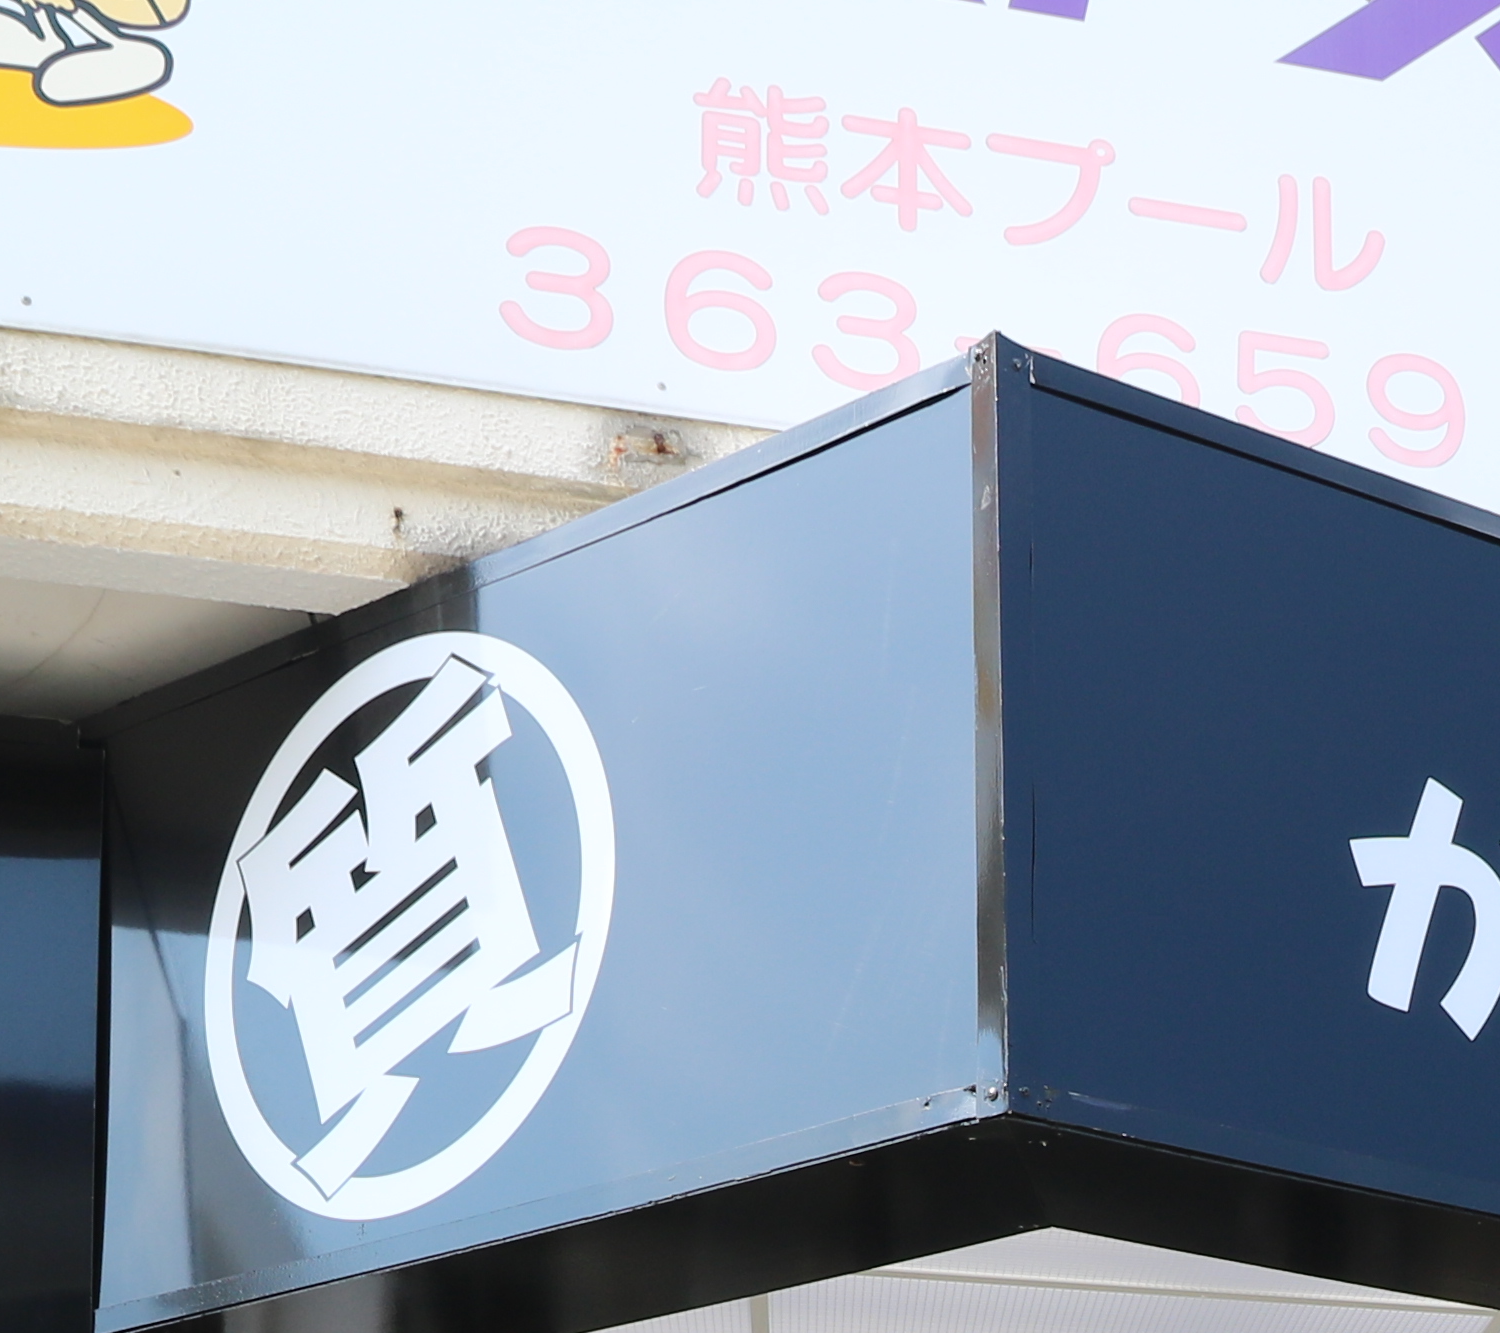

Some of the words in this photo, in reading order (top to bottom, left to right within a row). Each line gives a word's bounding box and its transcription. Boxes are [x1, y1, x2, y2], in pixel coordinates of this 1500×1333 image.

[693, 75, 1386, 293] 熊本プール
[235, 652, 580, 1202] 質
